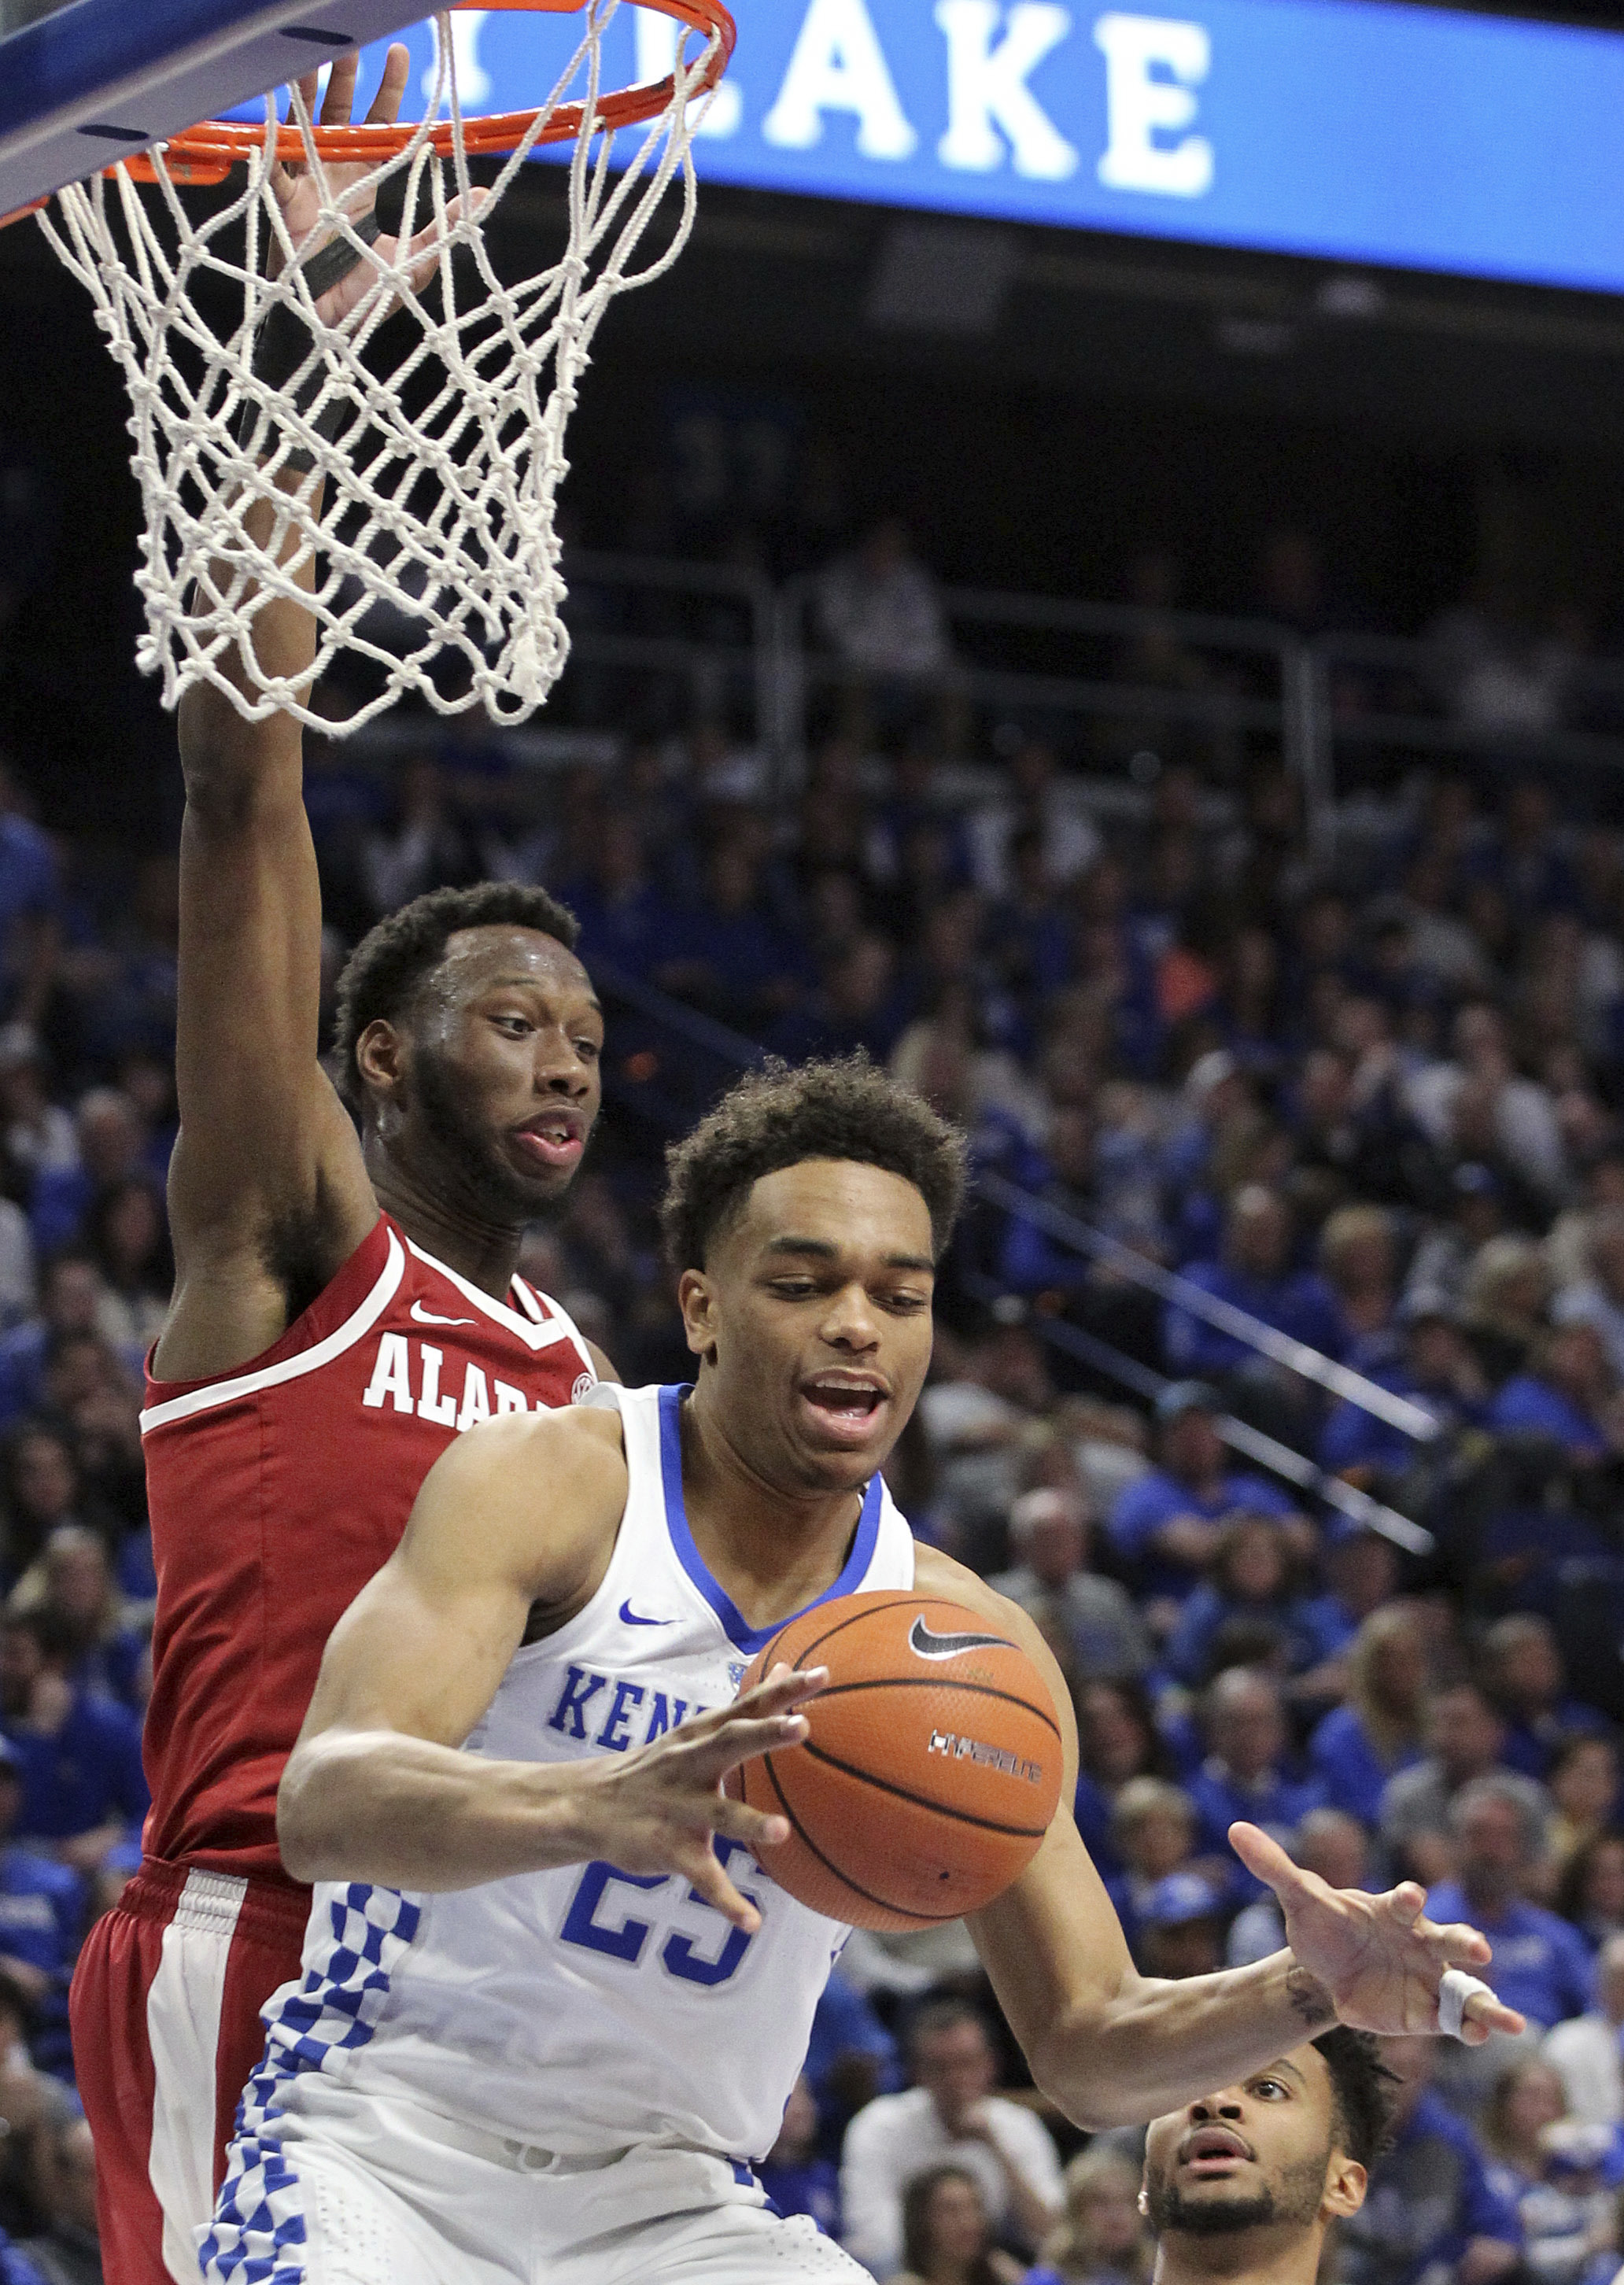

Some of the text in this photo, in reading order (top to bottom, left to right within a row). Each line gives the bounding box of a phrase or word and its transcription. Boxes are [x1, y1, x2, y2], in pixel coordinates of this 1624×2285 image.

[634, 0, 1216, 198] LAKE
[363, 1331, 552, 1433] ALA
[548, 1666, 712, 1752] KEN
